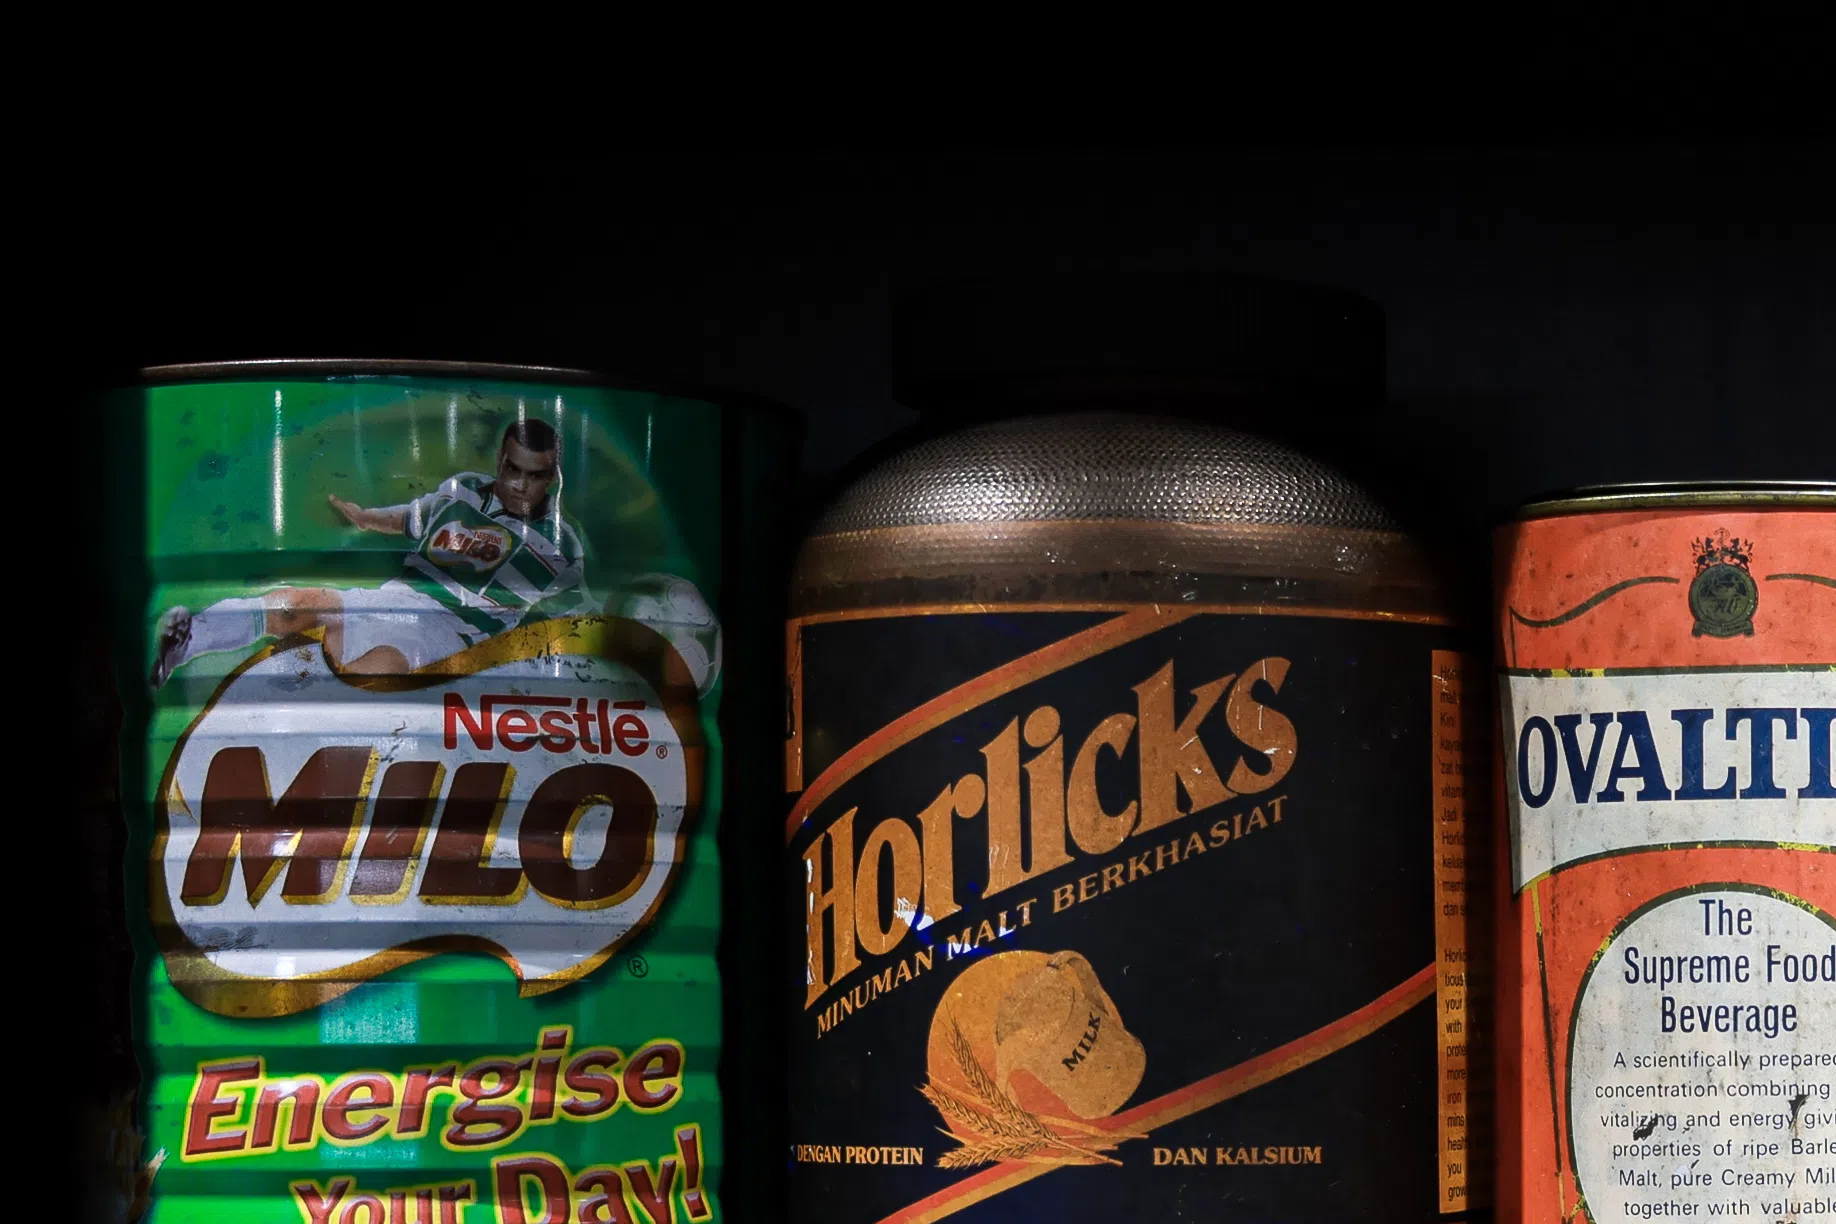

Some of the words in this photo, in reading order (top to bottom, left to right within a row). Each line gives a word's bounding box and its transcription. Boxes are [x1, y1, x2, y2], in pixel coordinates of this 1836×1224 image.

[180, 744, 657, 910] MILO
[803, 656, 1297, 1012] Horlicks
[816, 945, 937, 1040] MINUMAN
[946, 898, 1039, 962] MALT
[1052, 795, 1290, 915] BERKHASIAT
[1699, 899, 1754, 937] The
[1624, 946, 1751, 990] Supreme
[1445, 1000, 1463, 1015] your
[1661, 996, 1799, 1039] Beverage
[1446, 1020, 1463, 1034] with
[1062, 1010, 1104, 1073] MILK
[1613, 1052, 1627, 1068] A
[1633, 1049, 1750, 1071] scientifically
[182, 1026, 683, 1159] Energise
[1447, 1092, 1462, 1105] iron
[1595, 1082, 1718, 1099] concentration
[1726, 1080, 1831, 1100] combining
[1600, 1110, 1677, 1132] vitalizing
[1685, 1110, 1721, 1129] and
[1729, 1112, 1795, 1133] energy
[797, 1144, 842, 1164] DENGAN
[845, 1146, 924, 1165] PROTEIN
[1153, 1147, 1209, 1165] DAN
[1215, 1146, 1323, 1165] KALSIUM
[1612, 1139, 1701, 1161] properties
[1713, 1138, 1733, 1157] of
[1743, 1138, 1780, 1161] ripe
[1448, 1163, 1462, 1178] you
[1619, 1170, 1663, 1189] Malt,
[1671, 1172, 1713, 1192] pure
[1721, 1169, 1796, 1191] Creamy
[1624, 1200, 1700, 1222] together
[1708, 1199, 1751, 1216] with
